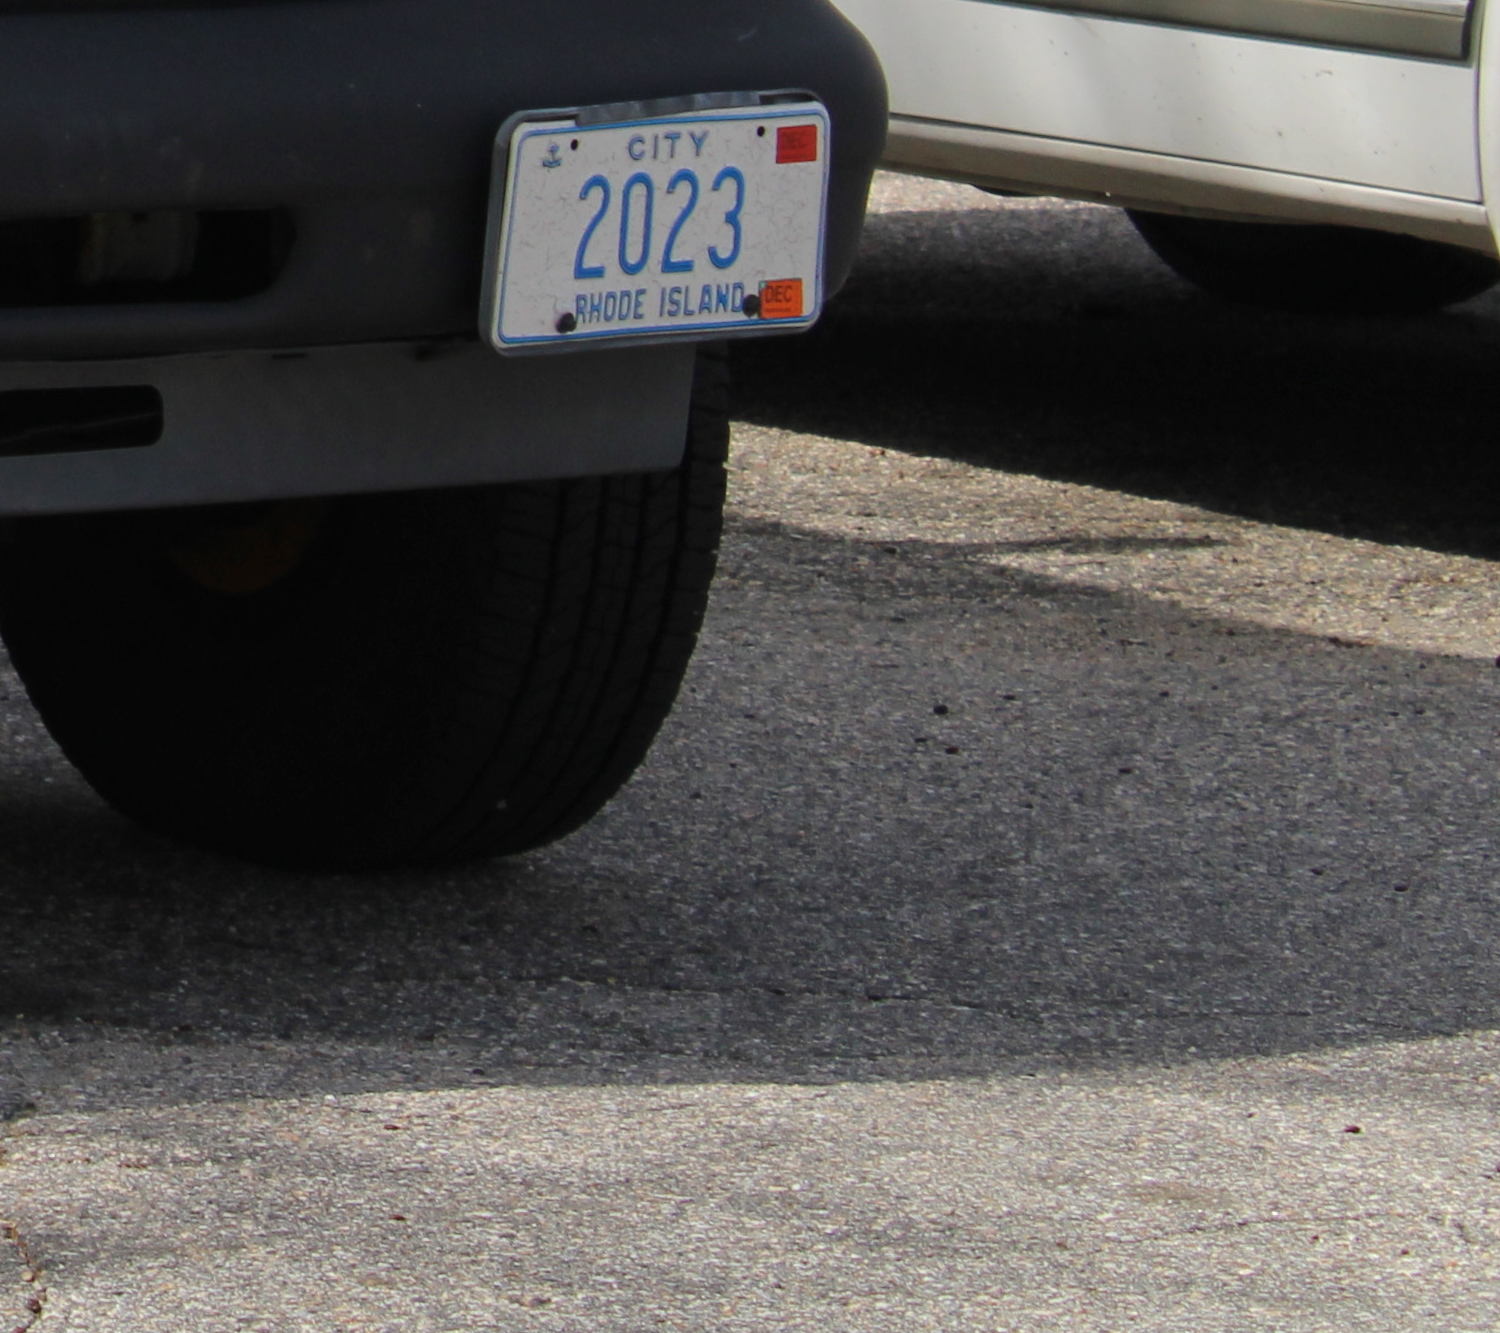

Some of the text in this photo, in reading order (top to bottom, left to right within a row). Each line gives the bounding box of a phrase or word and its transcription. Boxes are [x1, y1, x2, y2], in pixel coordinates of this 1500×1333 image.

[628, 130, 709, 161] CITY
[574, 166, 745, 280] 2023
[575, 282, 744, 324] RHODE ISLAND
[765, 285, 793, 303] DEC
